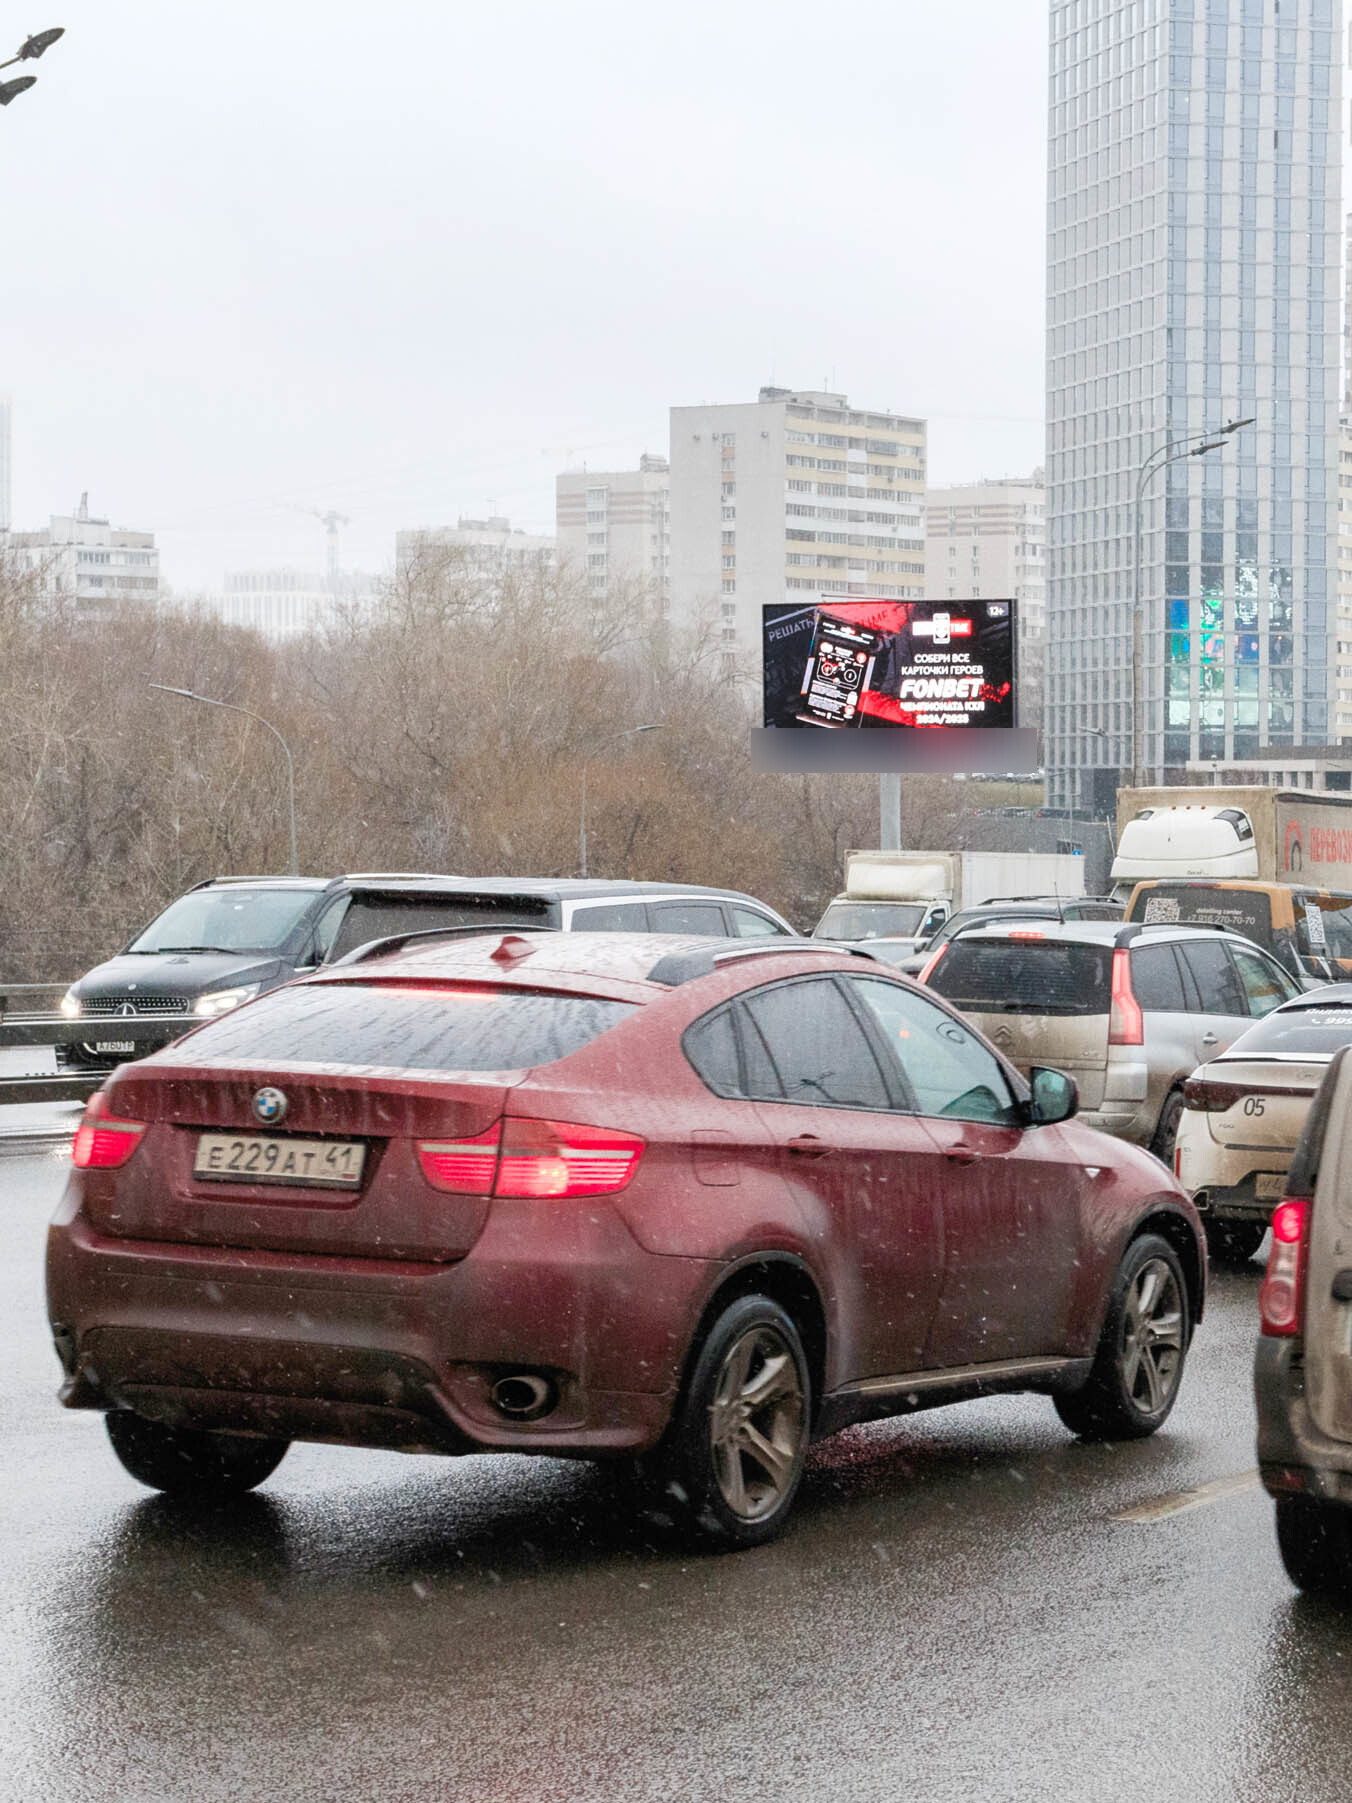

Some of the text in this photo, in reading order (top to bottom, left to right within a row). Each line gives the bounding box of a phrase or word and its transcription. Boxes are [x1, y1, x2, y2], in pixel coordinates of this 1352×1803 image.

[989, 606, 1005, 616] 12+
[768, 619, 814, 642] РЕШАТЬ
[914, 653, 971, 663] СОБЕРИ ВСЕ
[901, 665, 984, 675] КАРТОЧКИ ГЕРОЕВ
[900, 678, 985, 699] FONBET
[1244, 1098, 1266, 1117] 05
